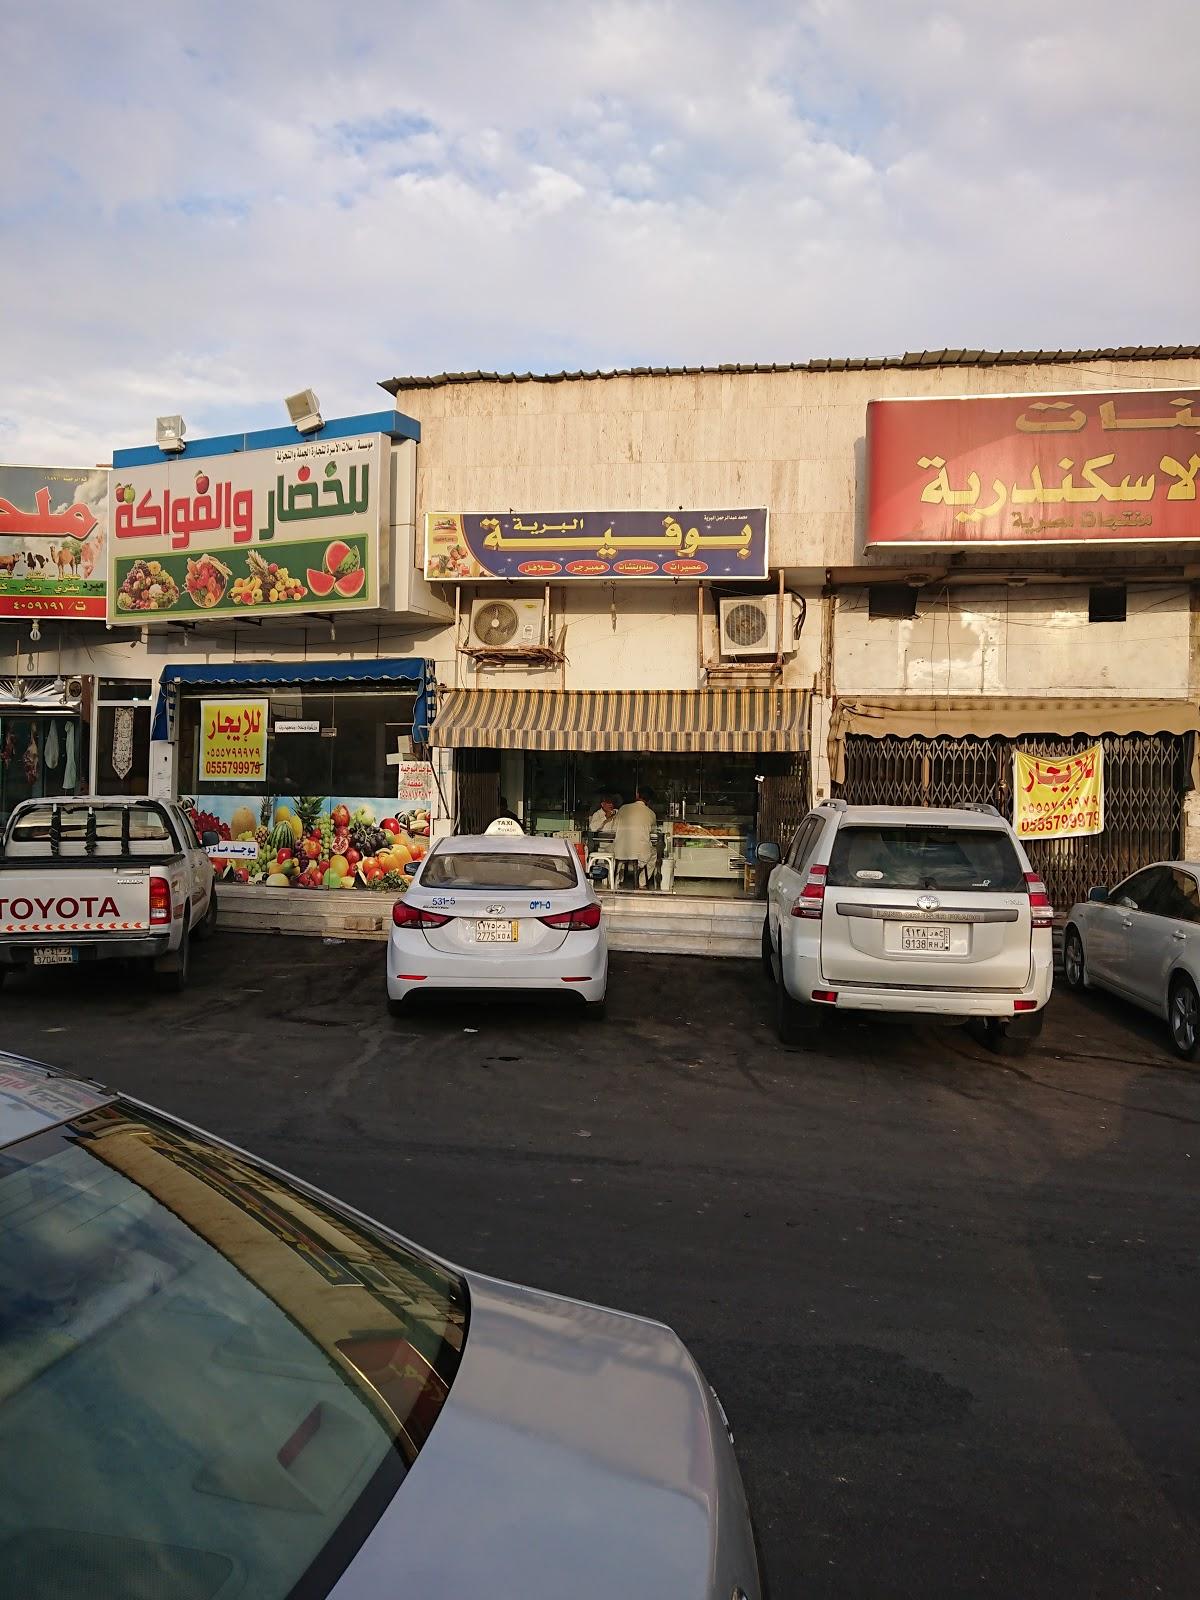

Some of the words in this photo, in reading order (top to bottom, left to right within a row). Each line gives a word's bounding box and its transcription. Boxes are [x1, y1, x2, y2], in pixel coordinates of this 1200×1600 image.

[258, 460, 370, 541] للخضار
[115, 470, 253, 550] والفواكة
[1081, 511, 1152, 531] منتجات
[512, 518, 584, 535] البرية
[524, 564, 556, 573] فلافل
[670, 563, 702, 573] عصيرات
[20, 583, 42, 593] ريش
[54, 583, 80, 594] بقري
[13, 601, 64, 611] ٤٠٥٩١٩١
[207, 709, 261, 741] للإيجار
[207, 748, 260, 758] ٠٥٥٥٧٩٩٩٧٩
[206, 761, 260, 774] 0555799979
[230, 847, 256, 857] يوجد
[432, 898, 456, 906] 531-5
[0, 897, 121, 920] TOYOTA
[477, 932, 496, 941] 2775
[905, 928, 927, 937] ٩١٣٨
[905, 939, 927, 949] 9138
[929, 941, 944, 949] RHJ
